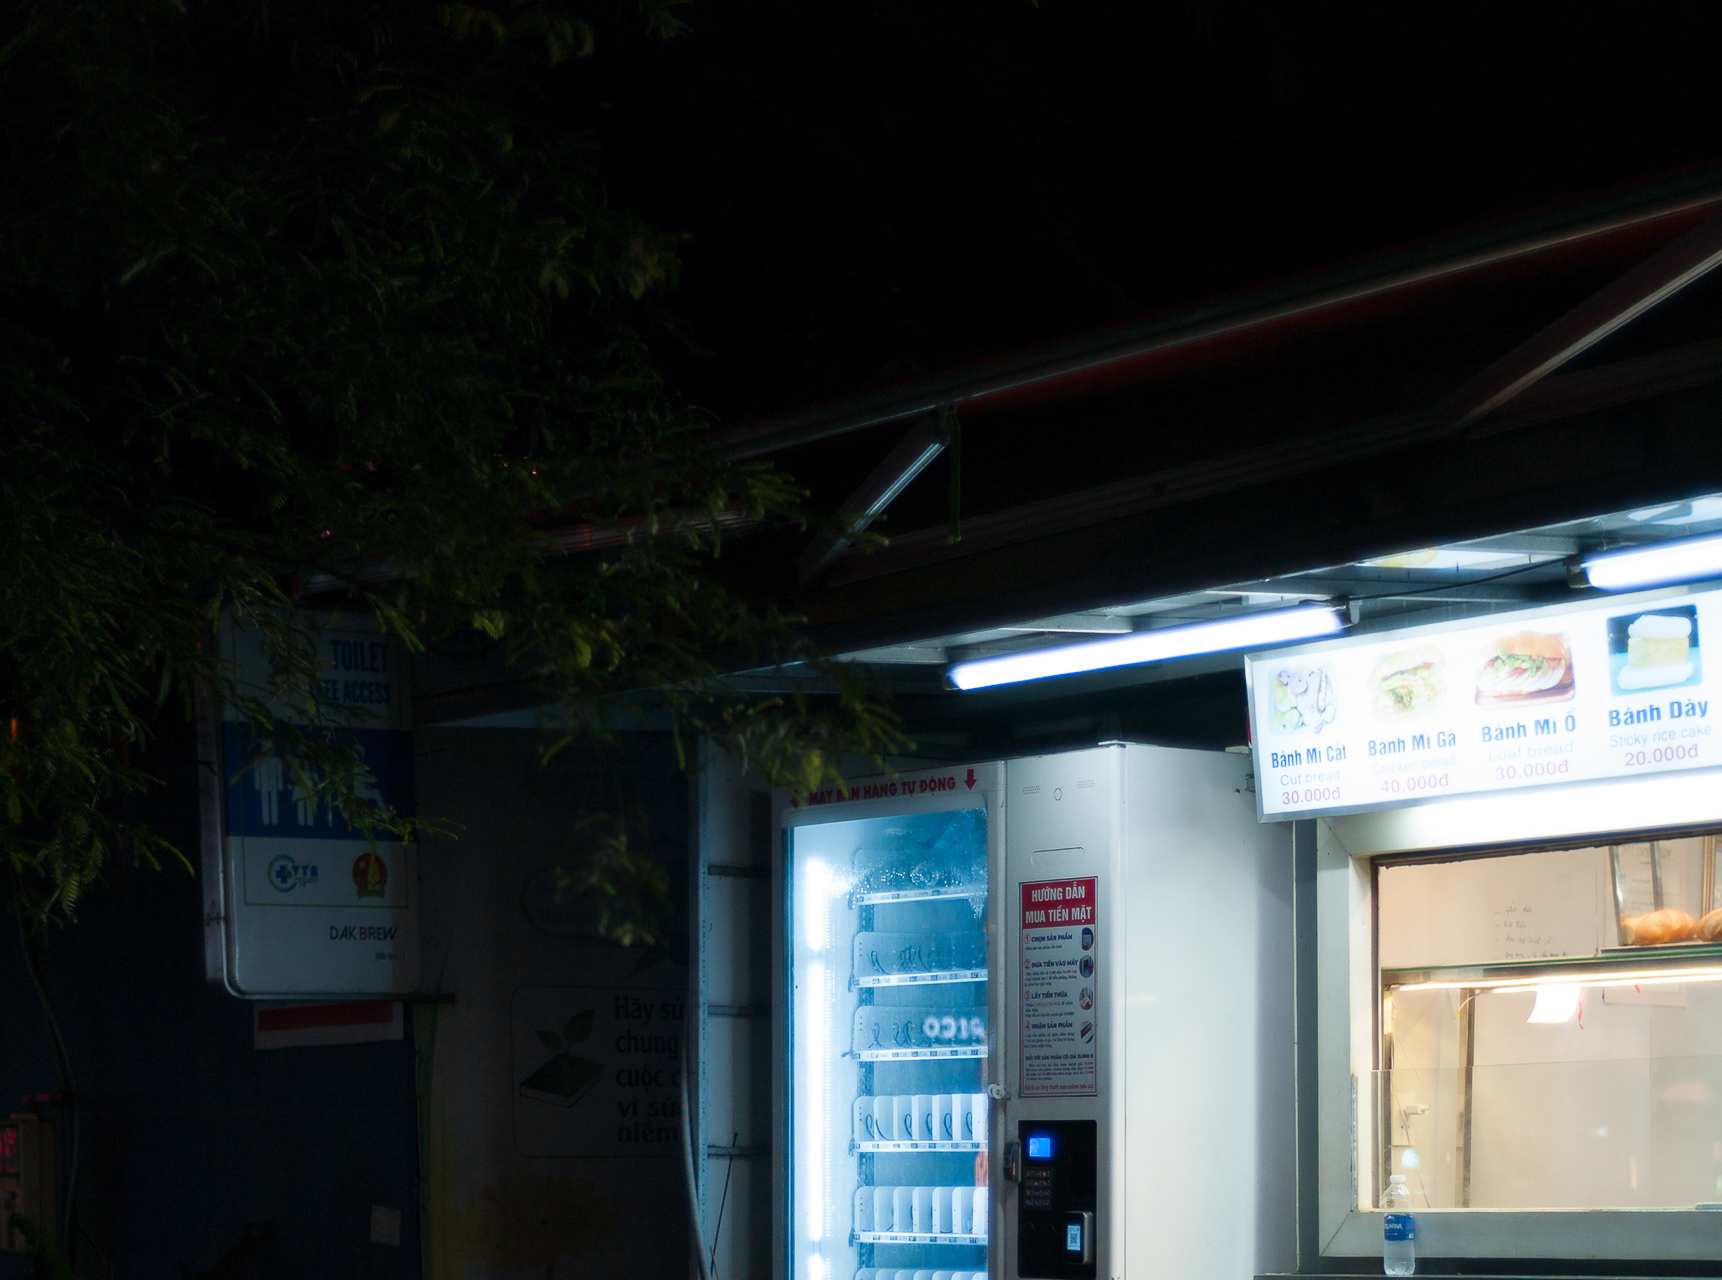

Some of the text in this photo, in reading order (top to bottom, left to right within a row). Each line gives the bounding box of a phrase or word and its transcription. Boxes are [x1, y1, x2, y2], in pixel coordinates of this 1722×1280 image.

[330, 640, 389, 673] TOILET
[343, 681, 391, 704] ACCESS
[1608, 704, 1662, 727] Bánh
[1481, 721, 1527, 743] Bánh
[1609, 724, 1712, 749] Sticky rice cake
[1368, 737, 1406, 757] Bánh
[1527, 741, 1574, 758] bread
[1625, 744, 1699, 767] 20.000đ
[1271, 750, 1302, 769] Bánh
[1372, 756, 1456, 776] Chicken bread
[1495, 759, 1569, 781] 30.000đ
[836, 786, 860, 802] BN
[863, 781, 898, 799] HÀNG
[918, 775, 956, 796] ĐỘNG
[1280, 770, 1341, 787] Cut bread
[1381, 773, 1449, 793] 40.000đ
[1282, 786, 1341, 805] 30.000đ
[1031, 881, 1086, 902] HƯỚNG DẪN
[1025, 910, 1046, 924] MUA
[329, 926, 398, 941] DAK BREW
[616, 1030, 679, 1060] chung
[616, 1063, 664, 1092] cuộc
[648, 1096, 681, 1117] sứ
